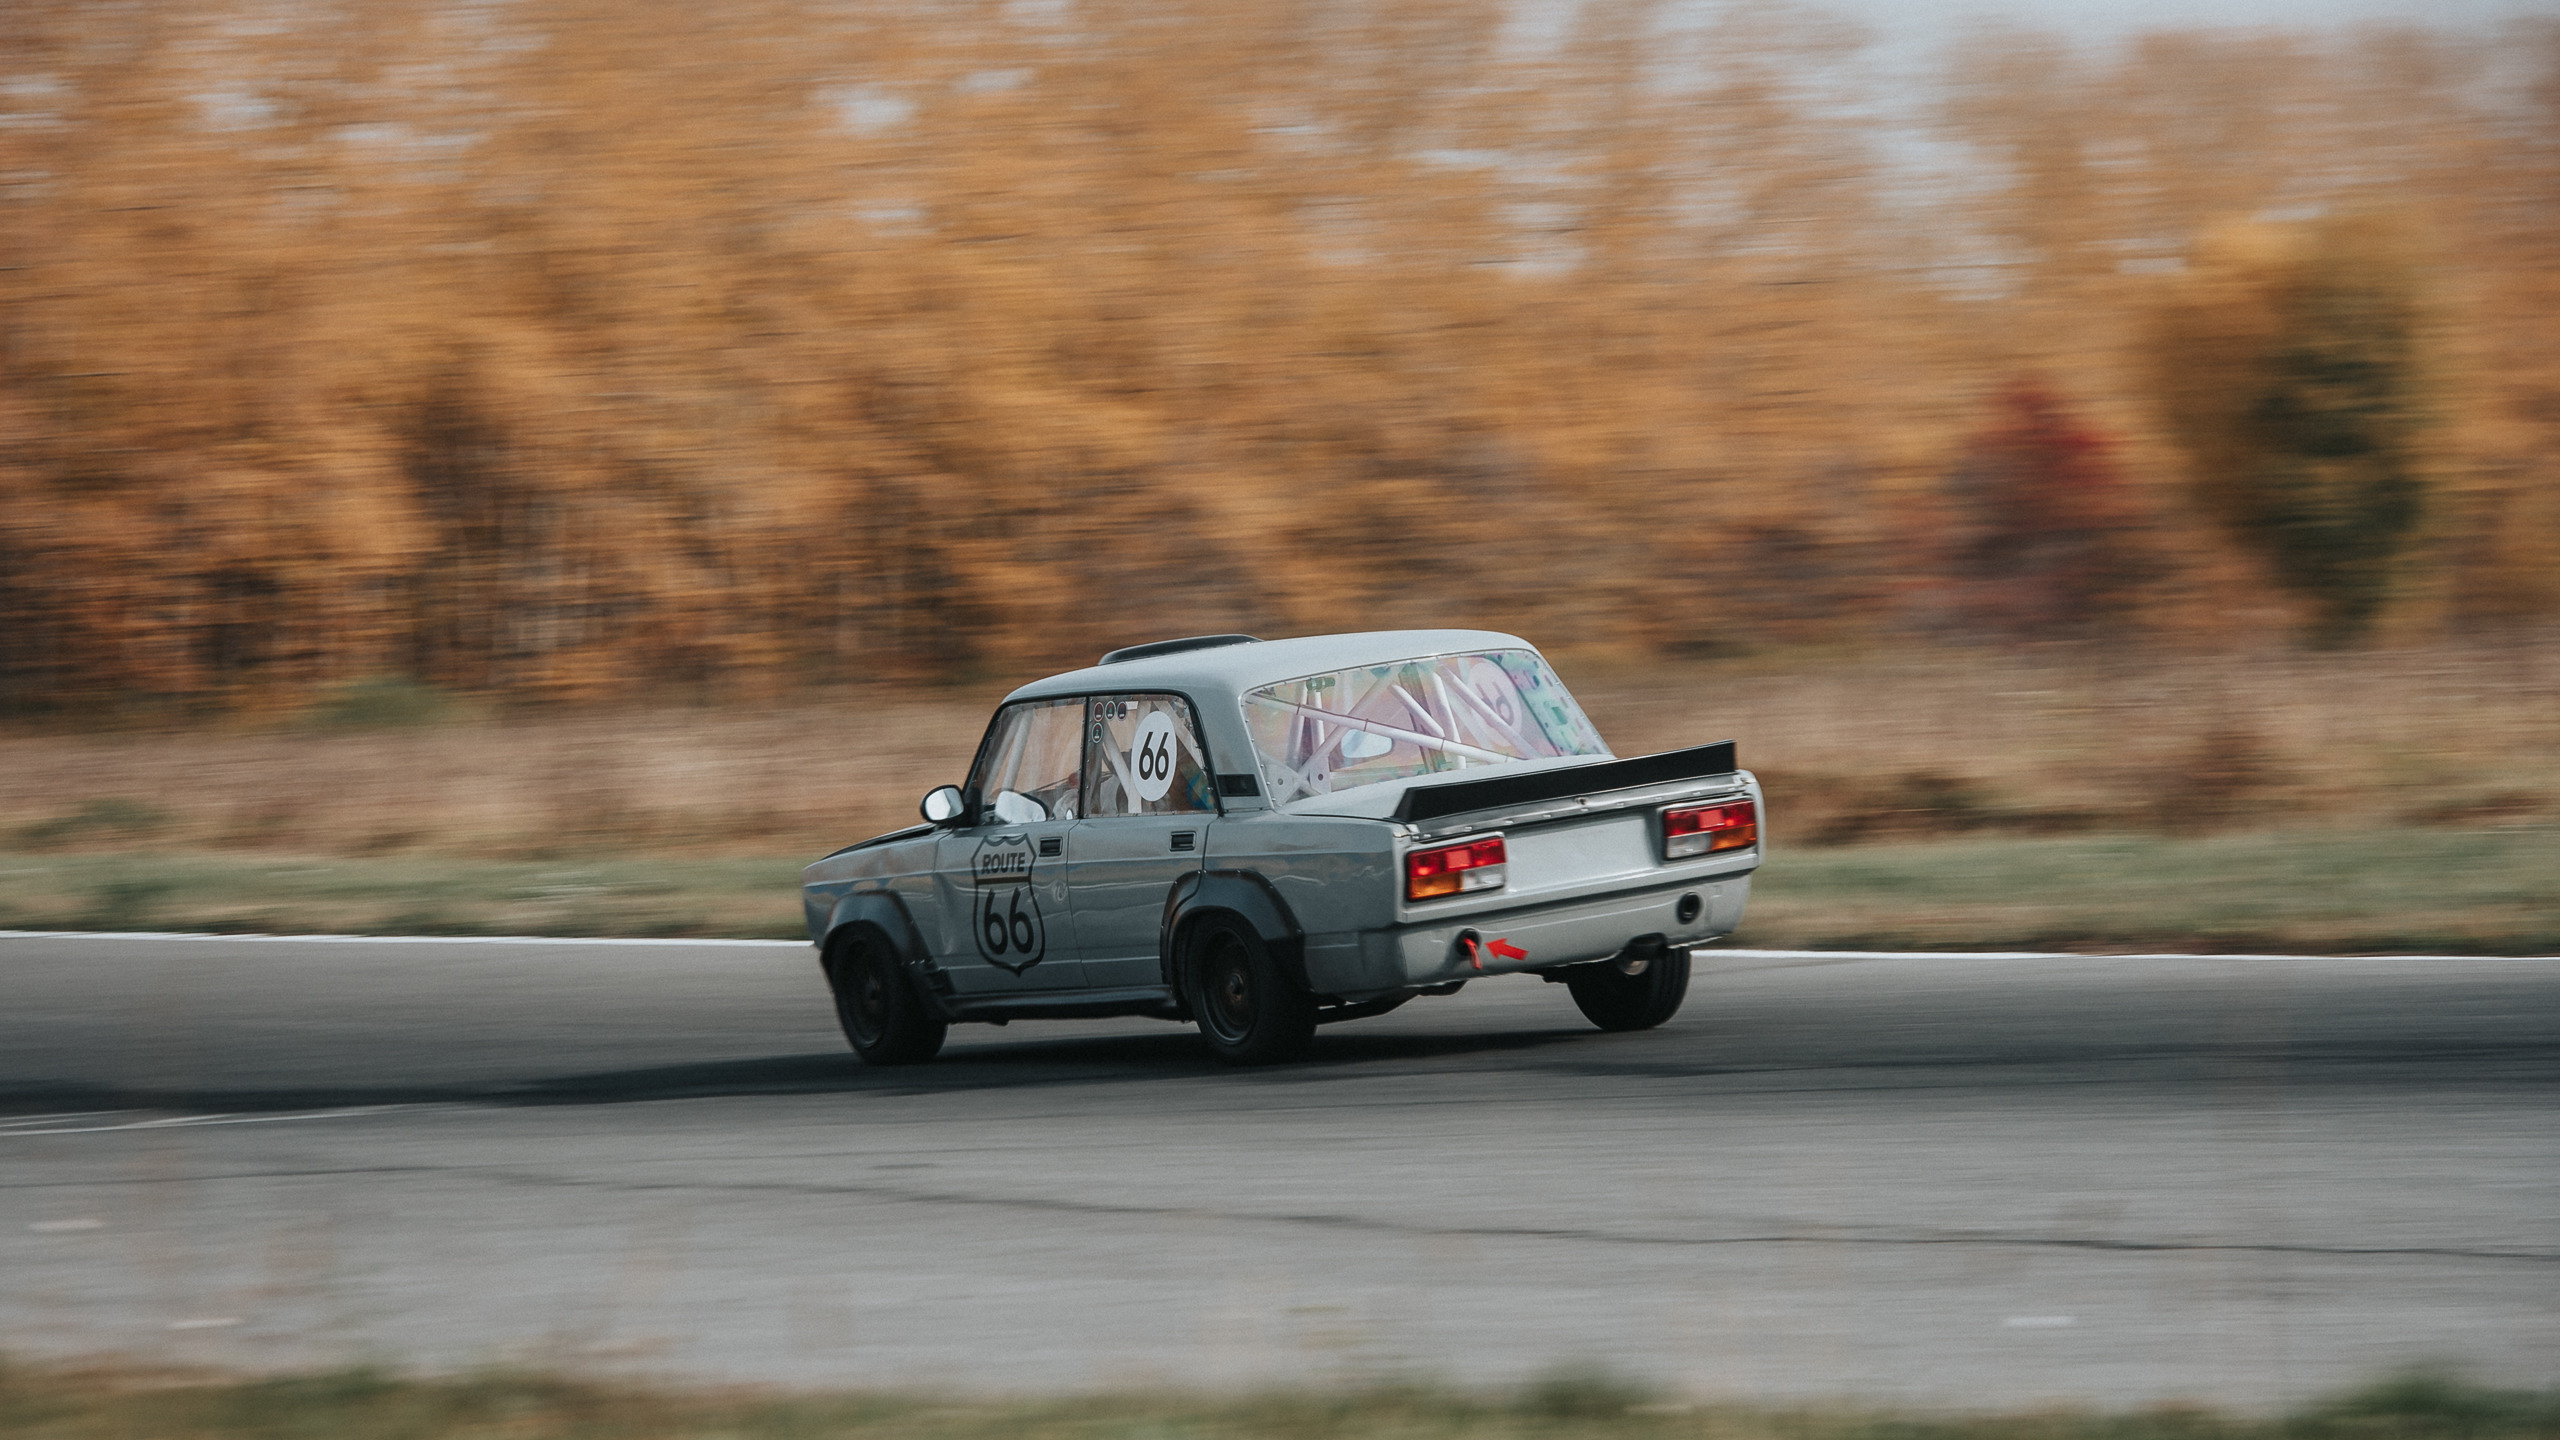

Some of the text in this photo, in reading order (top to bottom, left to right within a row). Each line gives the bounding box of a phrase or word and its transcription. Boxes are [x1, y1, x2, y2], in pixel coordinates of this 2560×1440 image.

[1138, 731, 1170, 781] 66
[981, 852, 1026, 875] ROUTE
[983, 886, 1035, 955] 66
